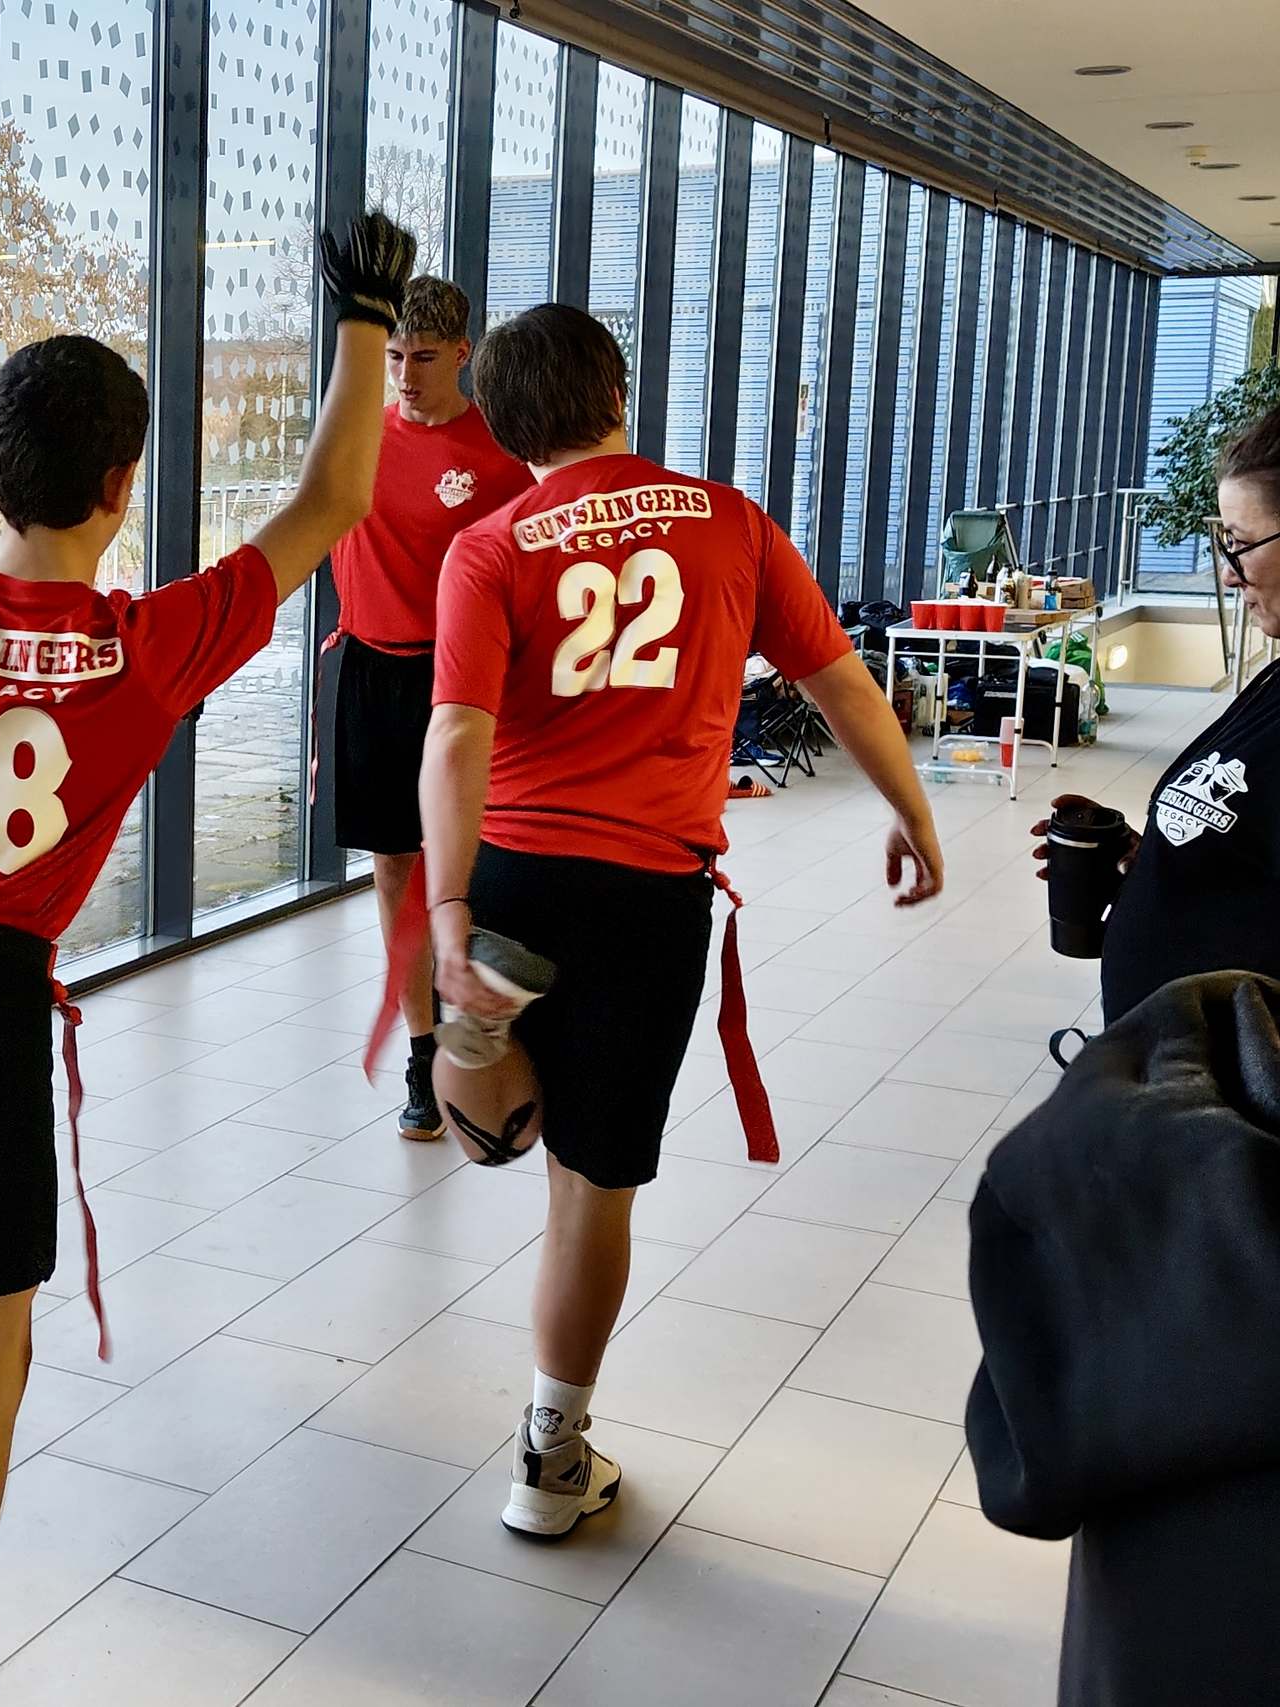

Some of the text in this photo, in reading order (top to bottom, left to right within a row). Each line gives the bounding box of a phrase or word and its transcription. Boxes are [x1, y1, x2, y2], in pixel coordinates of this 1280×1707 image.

[521, 488, 708, 544] GUNSLINGERS
[559, 520, 674, 553] LEGACY
[551, 547, 685, 698] 22
[1160, 807, 1203, 828] LEGACY
